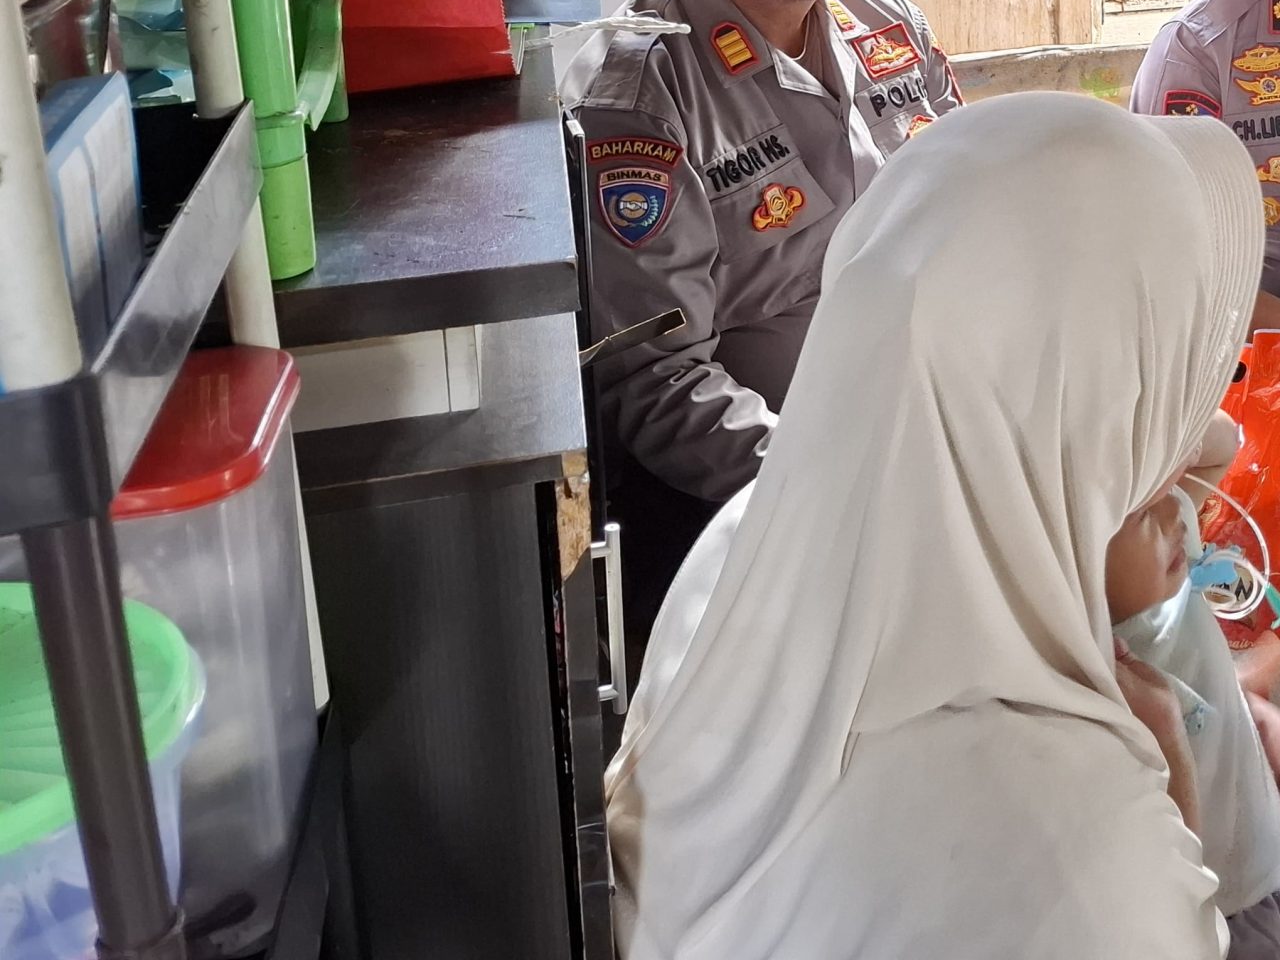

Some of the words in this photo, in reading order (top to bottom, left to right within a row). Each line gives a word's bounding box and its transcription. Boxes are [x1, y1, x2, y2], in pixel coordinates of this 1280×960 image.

[592, 141, 676, 162] BAHARKAM
[607, 170, 662, 181] BINMAS
[706, 146, 766, 192] TIGOR
